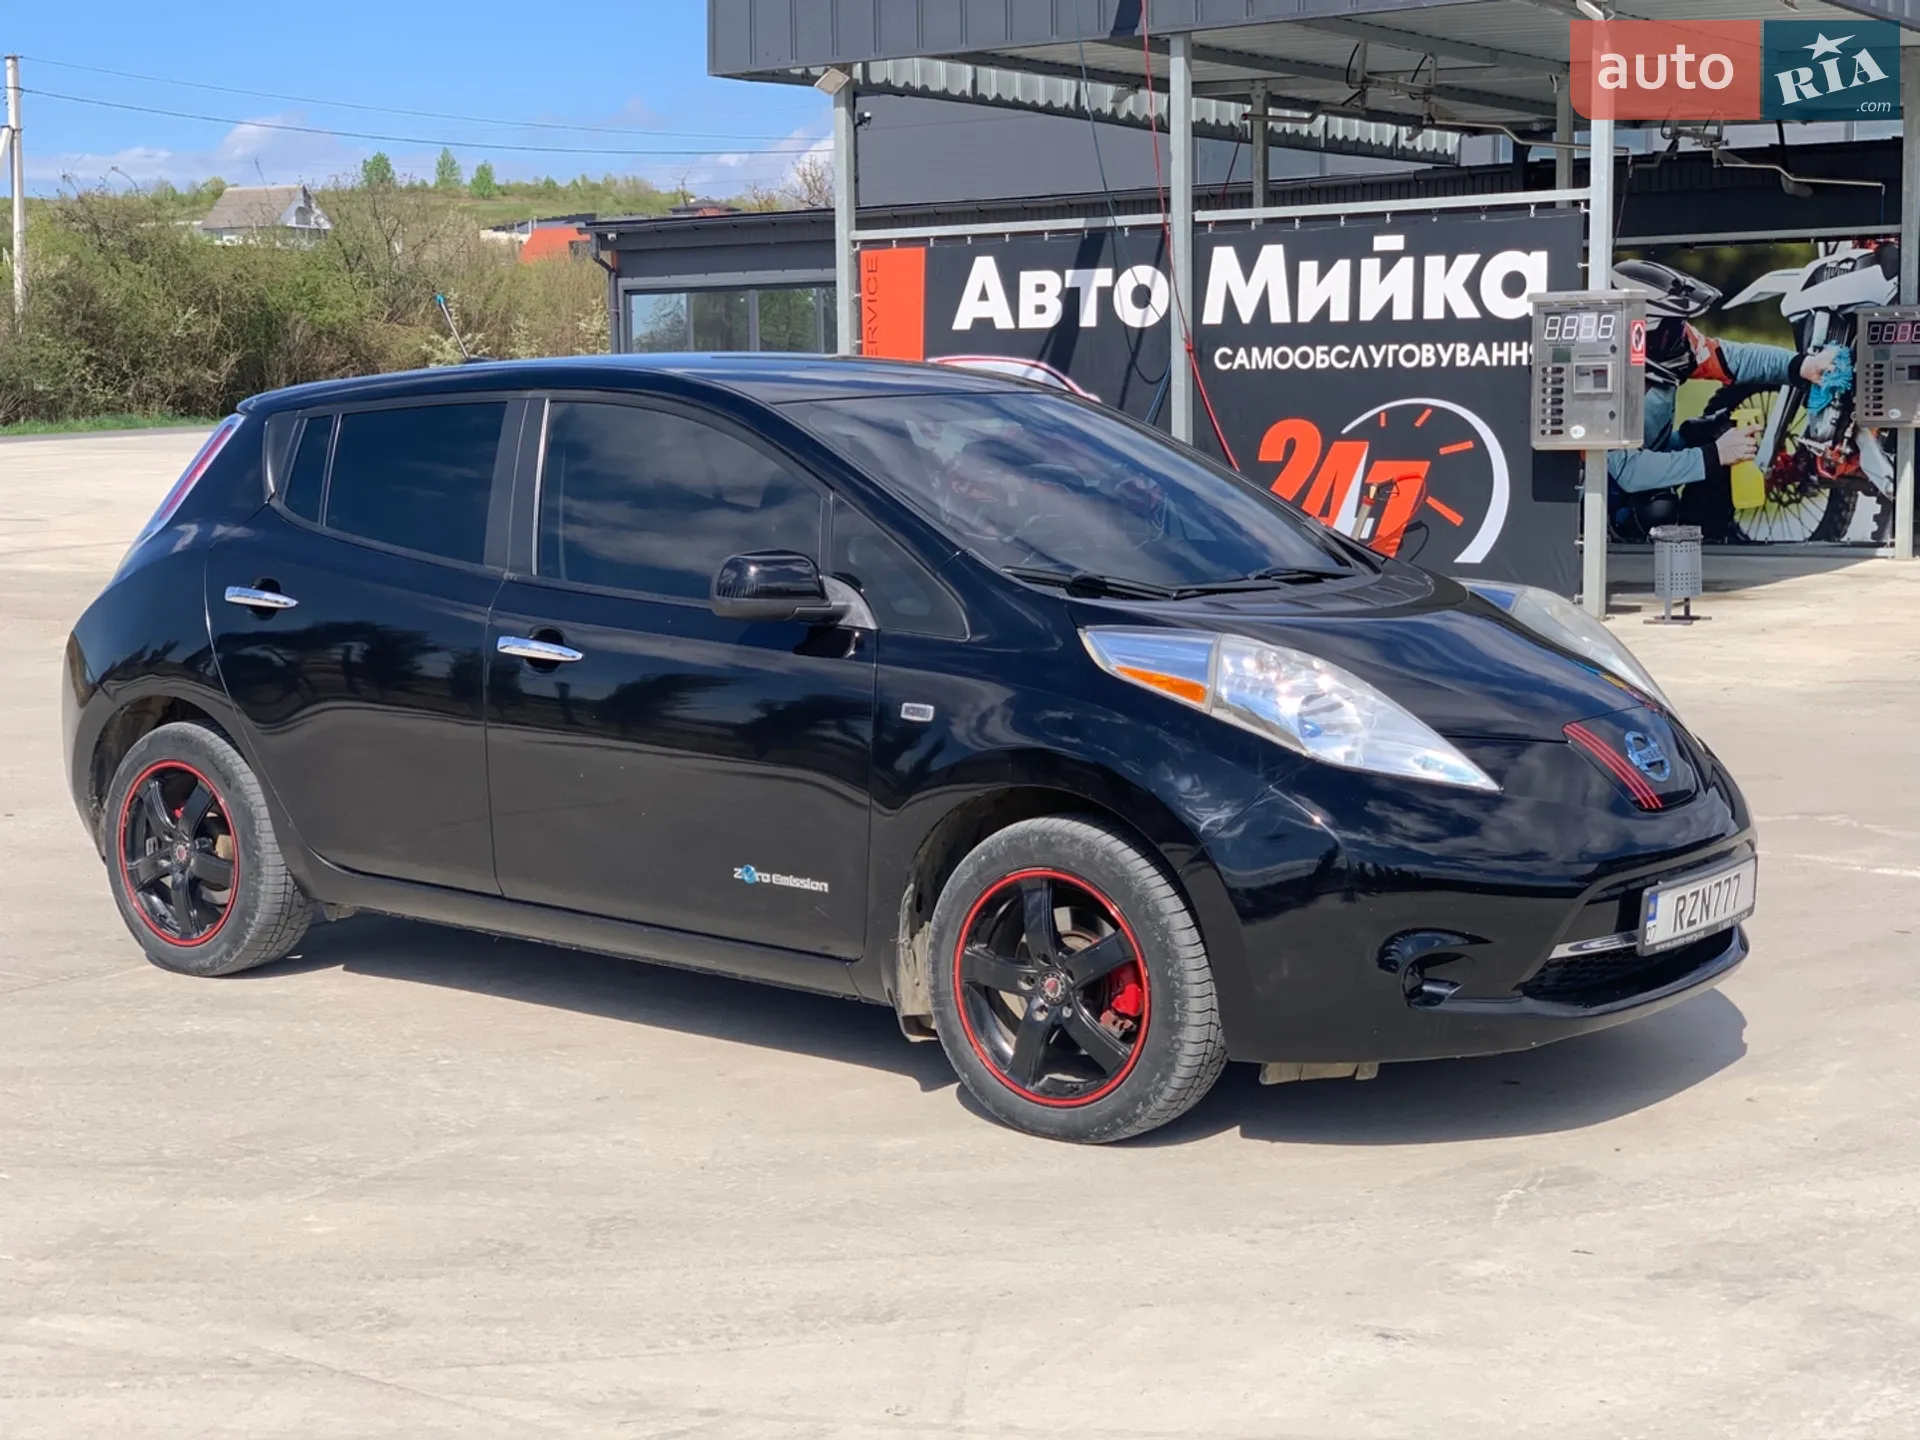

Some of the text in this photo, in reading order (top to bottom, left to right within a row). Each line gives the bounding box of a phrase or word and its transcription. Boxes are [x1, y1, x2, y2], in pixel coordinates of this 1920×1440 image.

[1201, 234, 1548, 326] Мийка
[772, 873, 829, 892] Emission
[1672, 873, 1741, 933] RZN777
